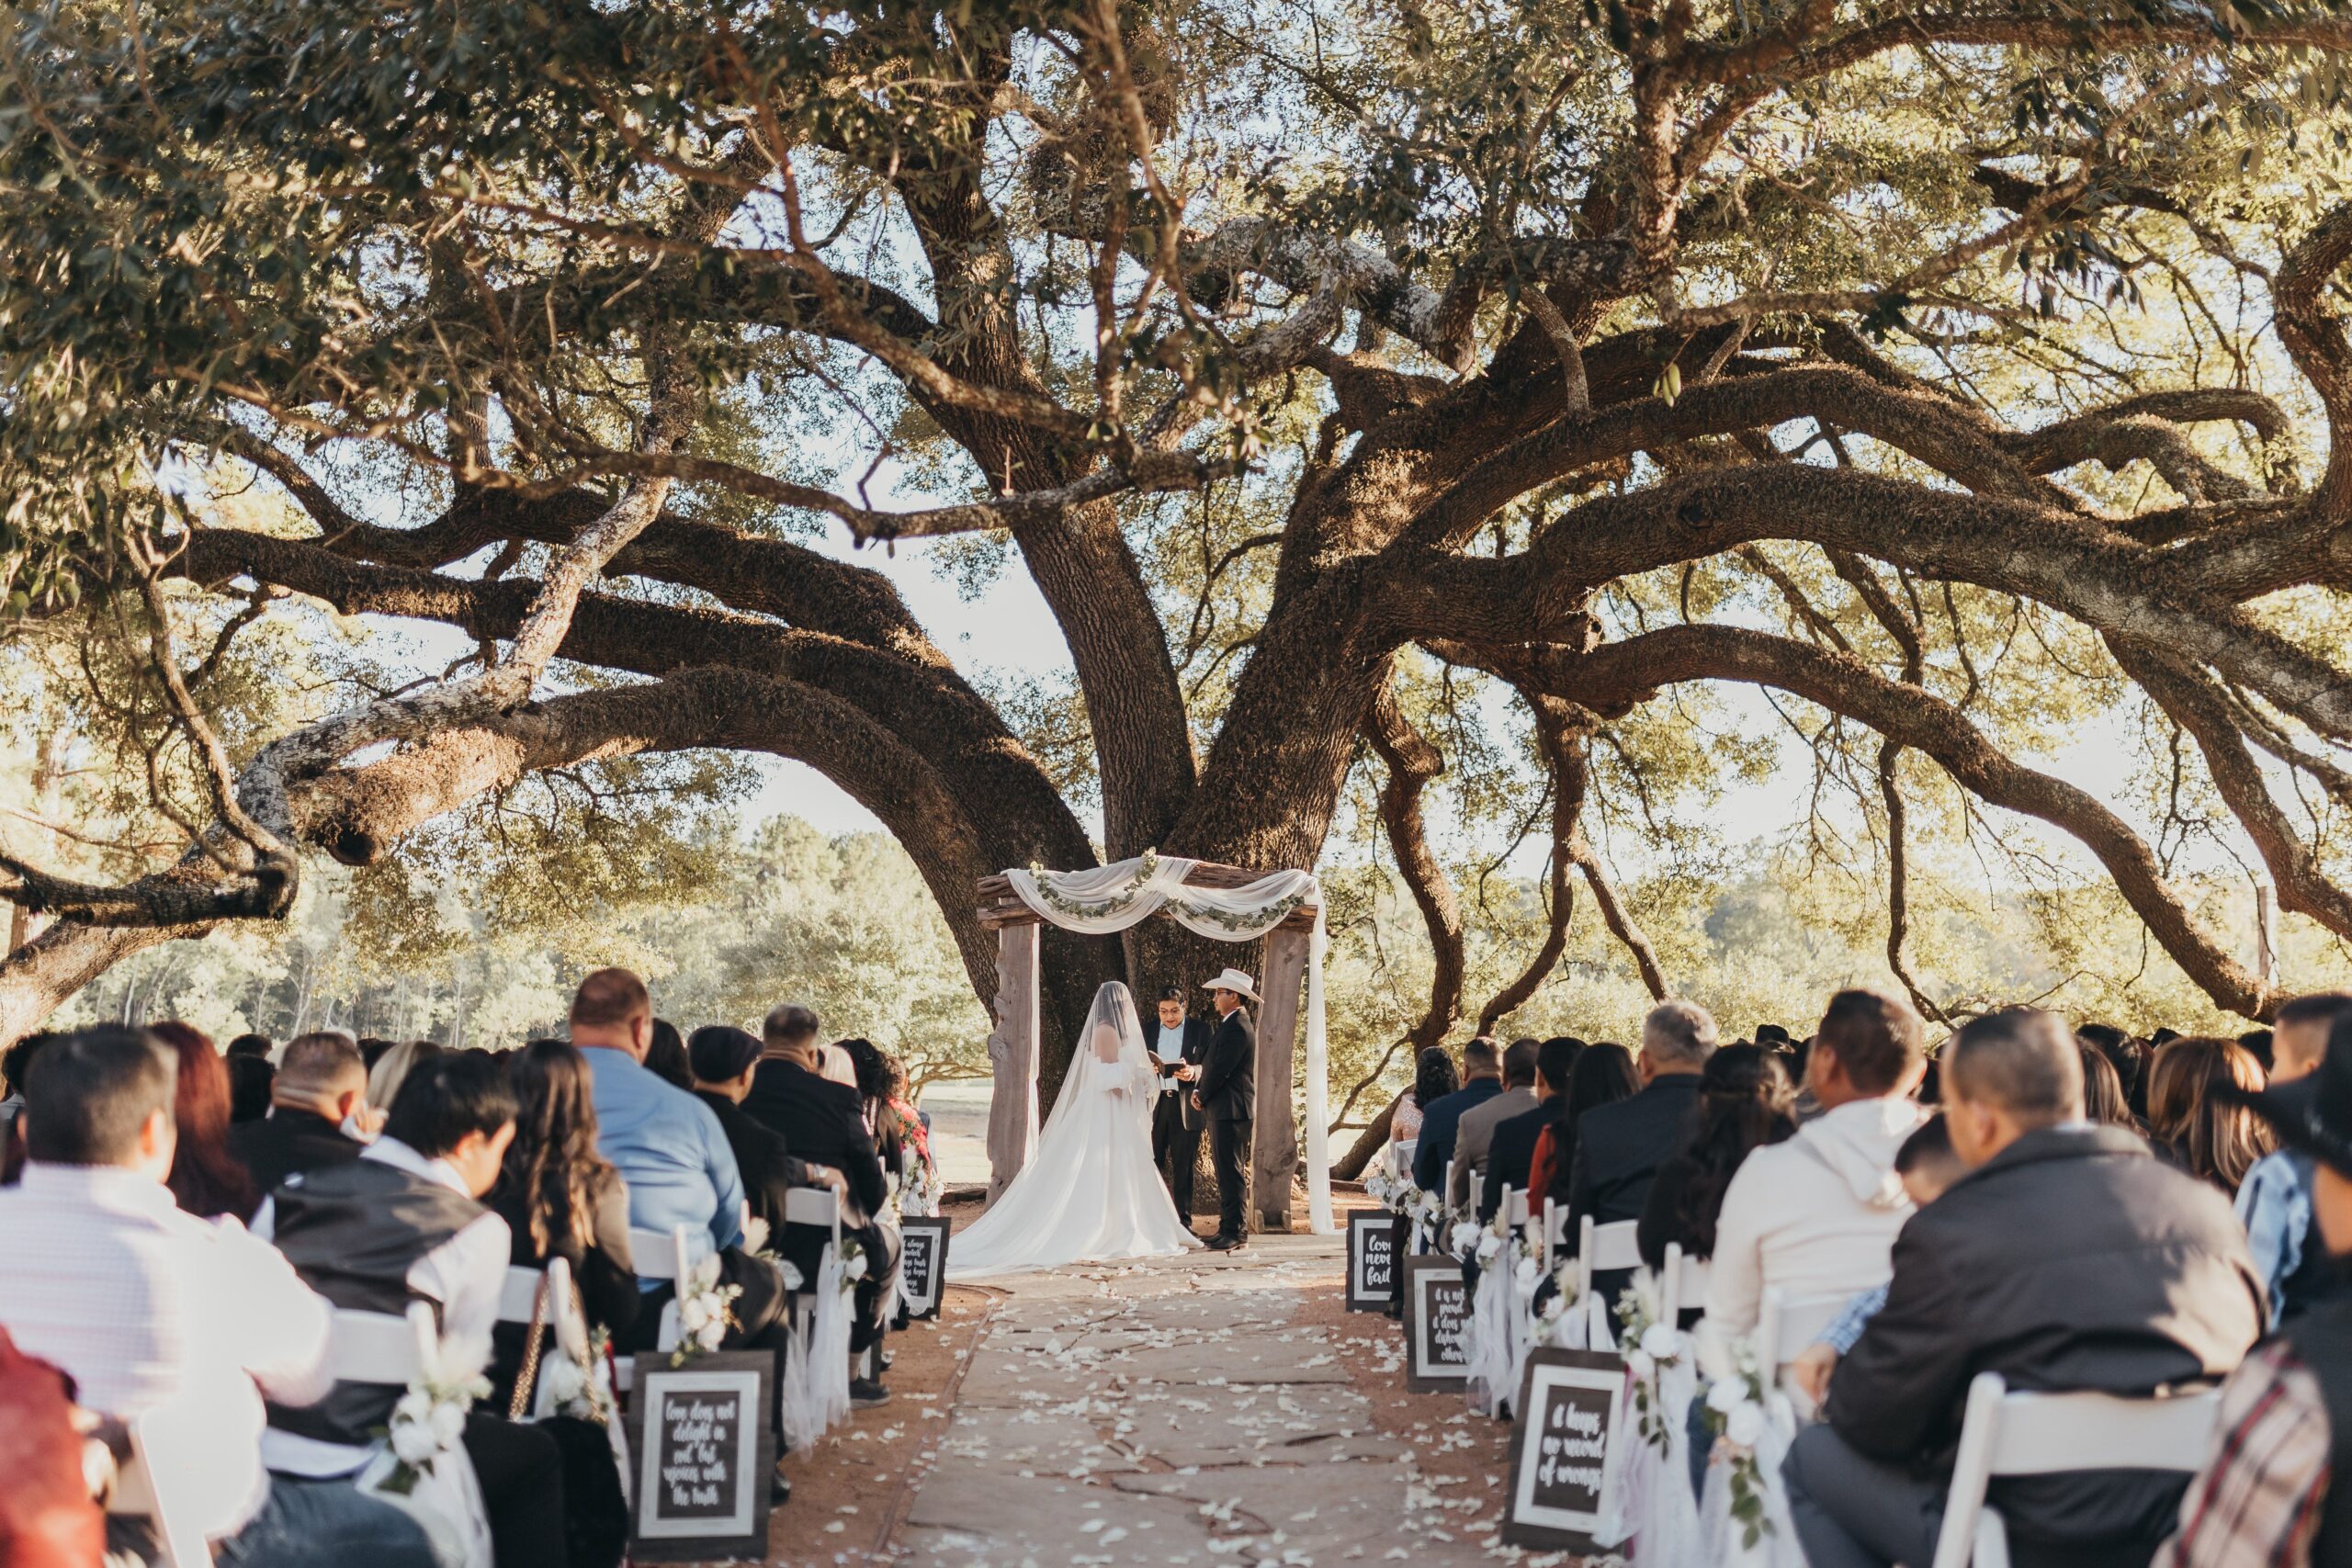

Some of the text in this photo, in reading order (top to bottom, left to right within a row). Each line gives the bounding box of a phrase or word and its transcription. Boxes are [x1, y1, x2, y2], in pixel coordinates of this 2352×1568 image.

[907, 1238, 924, 1250] always
[913, 1266, 926, 1278] hopes
[1435, 1287, 1465, 1303] it is not
[1439, 1300, 1464, 1318] proud
[1432, 1314, 1439, 1329] it
[1441, 1314, 1458, 1331] does
[1441, 1346, 1464, 1363] others
[665, 1398, 736, 1424] love does not
[1552, 1401, 1600, 1439] it keeps
[673, 1420, 727, 1449] delight in
[1543, 1430, 1606, 1459] no record
[673, 1441, 716, 1464] evil but
[662, 1461, 727, 1489] rejoices with
[1538, 1455, 1602, 1496] of wrongs
[673, 1484, 719, 1506] the truth
